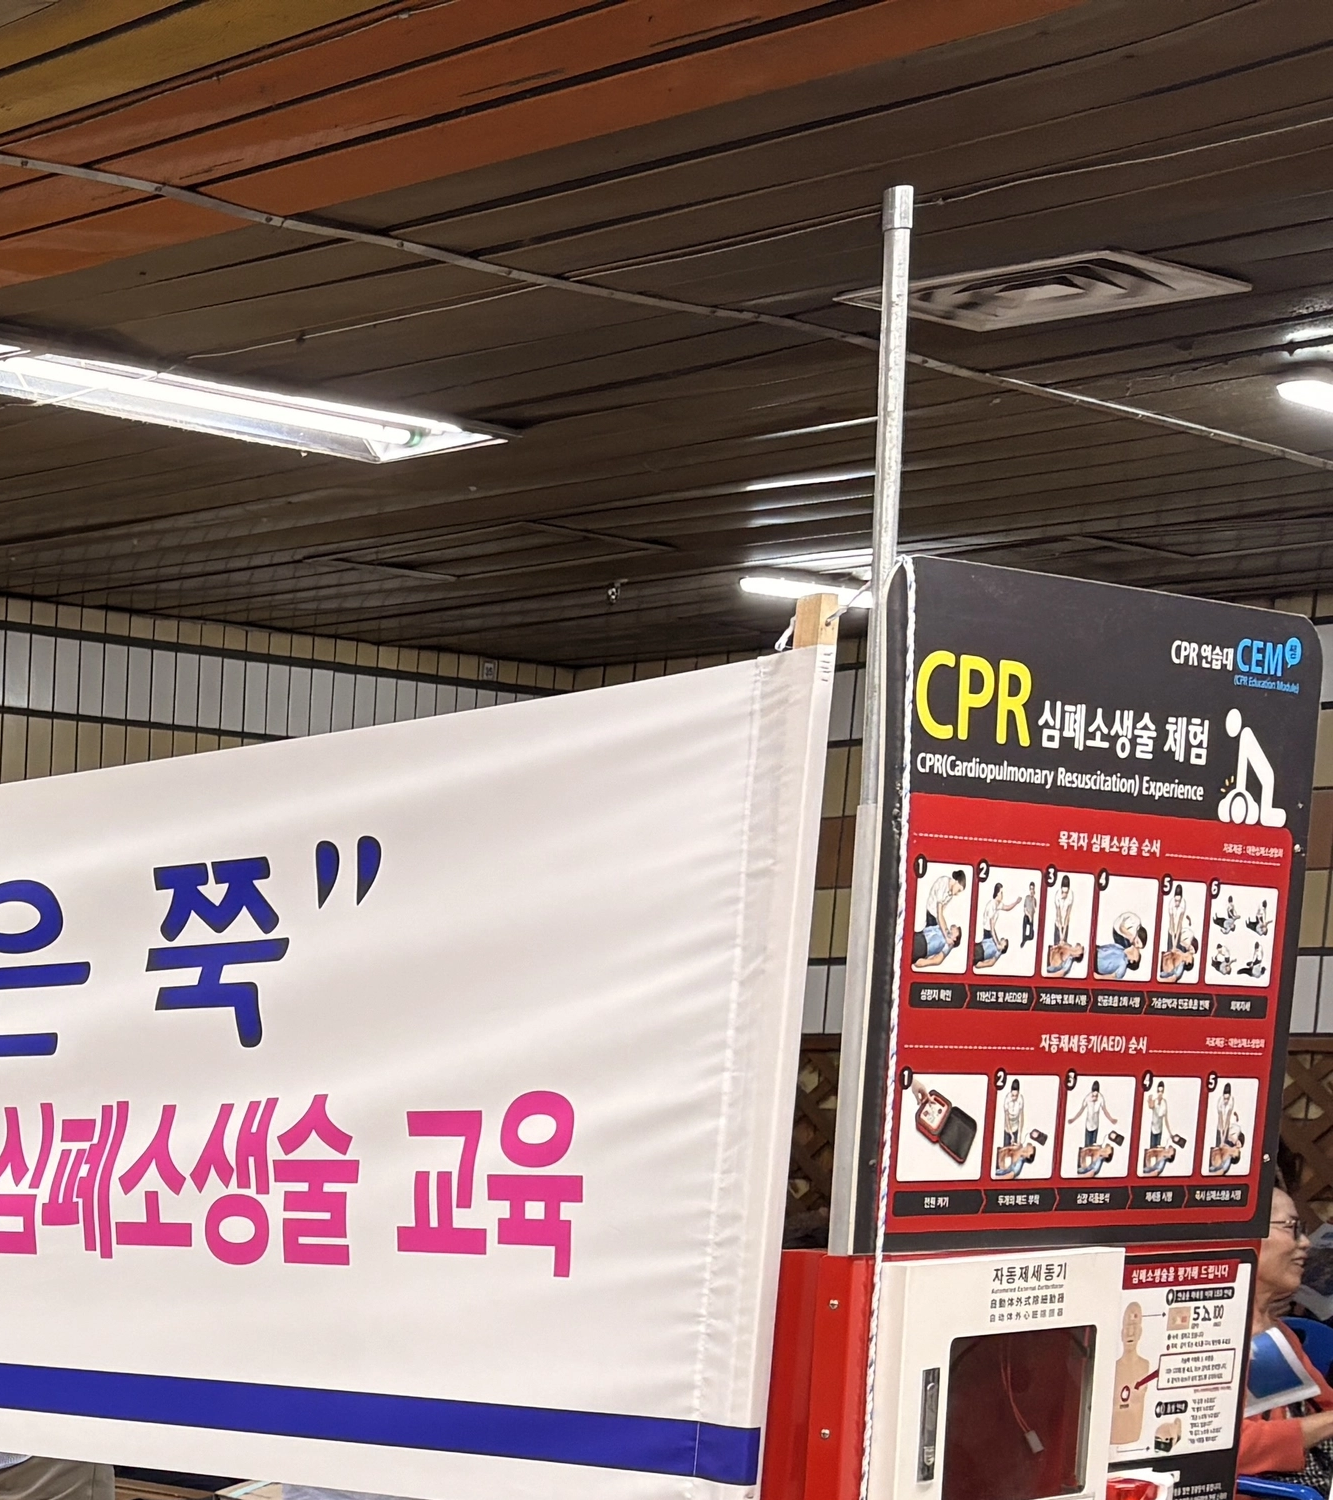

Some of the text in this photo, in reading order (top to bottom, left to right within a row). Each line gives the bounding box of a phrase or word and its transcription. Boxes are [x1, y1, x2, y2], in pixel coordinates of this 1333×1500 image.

[1171, 640, 1198, 666] CPR
[1201, 644, 1233, 671] 연습대
[1237, 639, 1283, 677] CEM
[916, 650, 1210, 766] CPR 심폐소생술 체험
[916, 752, 1204, 801] CPR(Cardiopulmonary Resuscitation) Experience
[1058, 830, 1161, 857] 목격자 심폐소생술 순서
[917, 858, 923, 875] 1
[979, 862, 987, 878] 2
[1047, 867, 1055, 883] 3
[1099, 871, 1107, 885] 4
[1163, 876, 1171, 890] 5
[1211, 881, 1219, 894] 6
[1039, 1034, 1147, 1054] 자동제세동기(AED) 순서
[903, 1070, 909, 1086] 1
[996, 1071, 1005, 1086] 2
[1066, 1072, 1074, 1087] 3
[1143, 1073, 1151, 1087] 4
[1208, 1074, 1215, 1089] 5
[396, 1089, 583, 1278] 교육
[992, 1262, 1067, 1285] 자동제세동기
[1132, 1264, 1229, 1284] 심폐소생술을 평가해 드립니다
